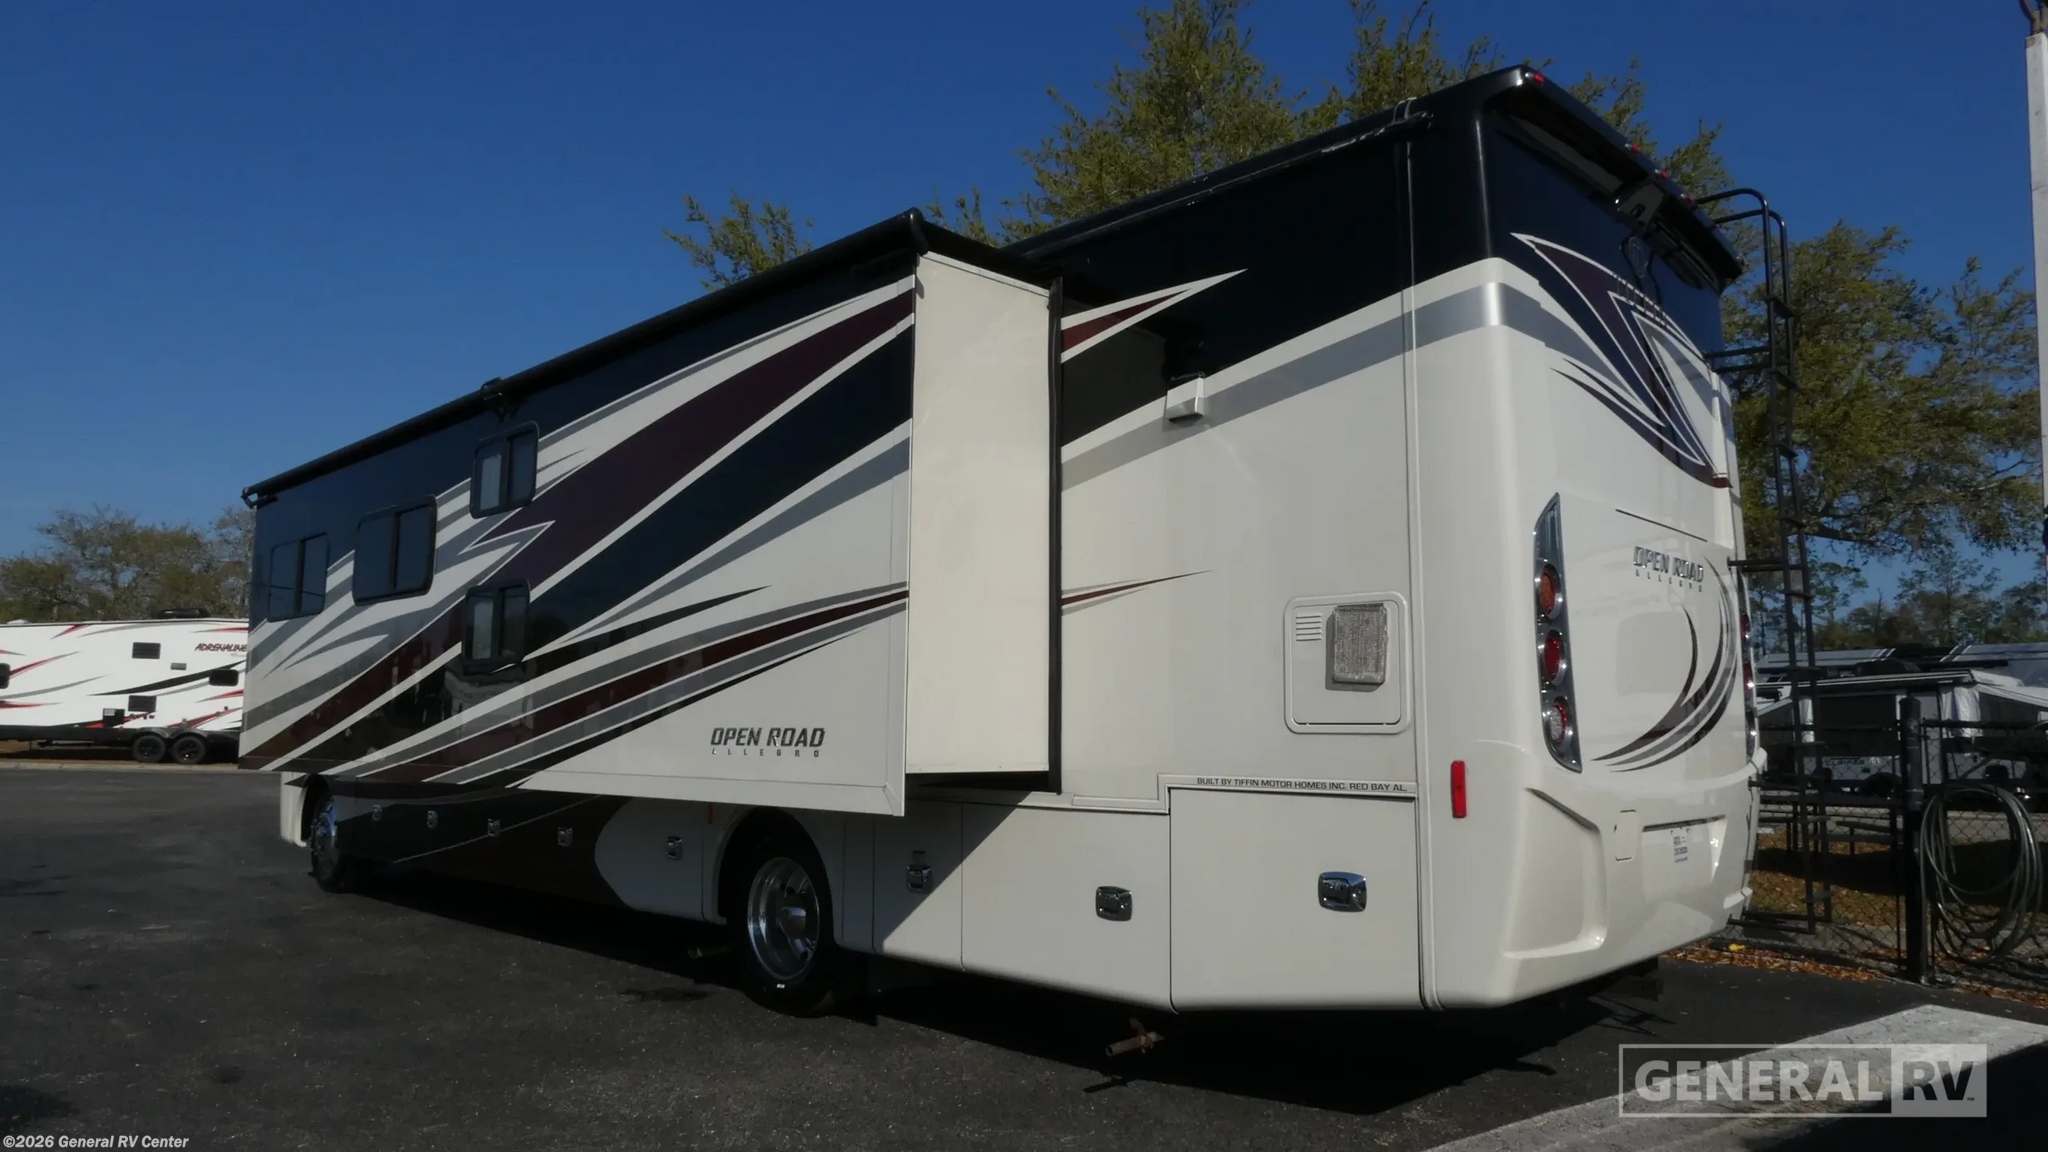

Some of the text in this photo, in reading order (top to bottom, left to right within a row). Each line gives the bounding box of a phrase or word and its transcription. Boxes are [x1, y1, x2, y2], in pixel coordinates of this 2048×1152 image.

[1633, 546, 1704, 582] OPEN ROAD
[710, 727, 826, 747] OPEN ROAD
[711, 748, 819, 757] ALLEGRO
[1261, 780, 1293, 788] MOTOR
[1294, 781, 1327, 789] HOMES
